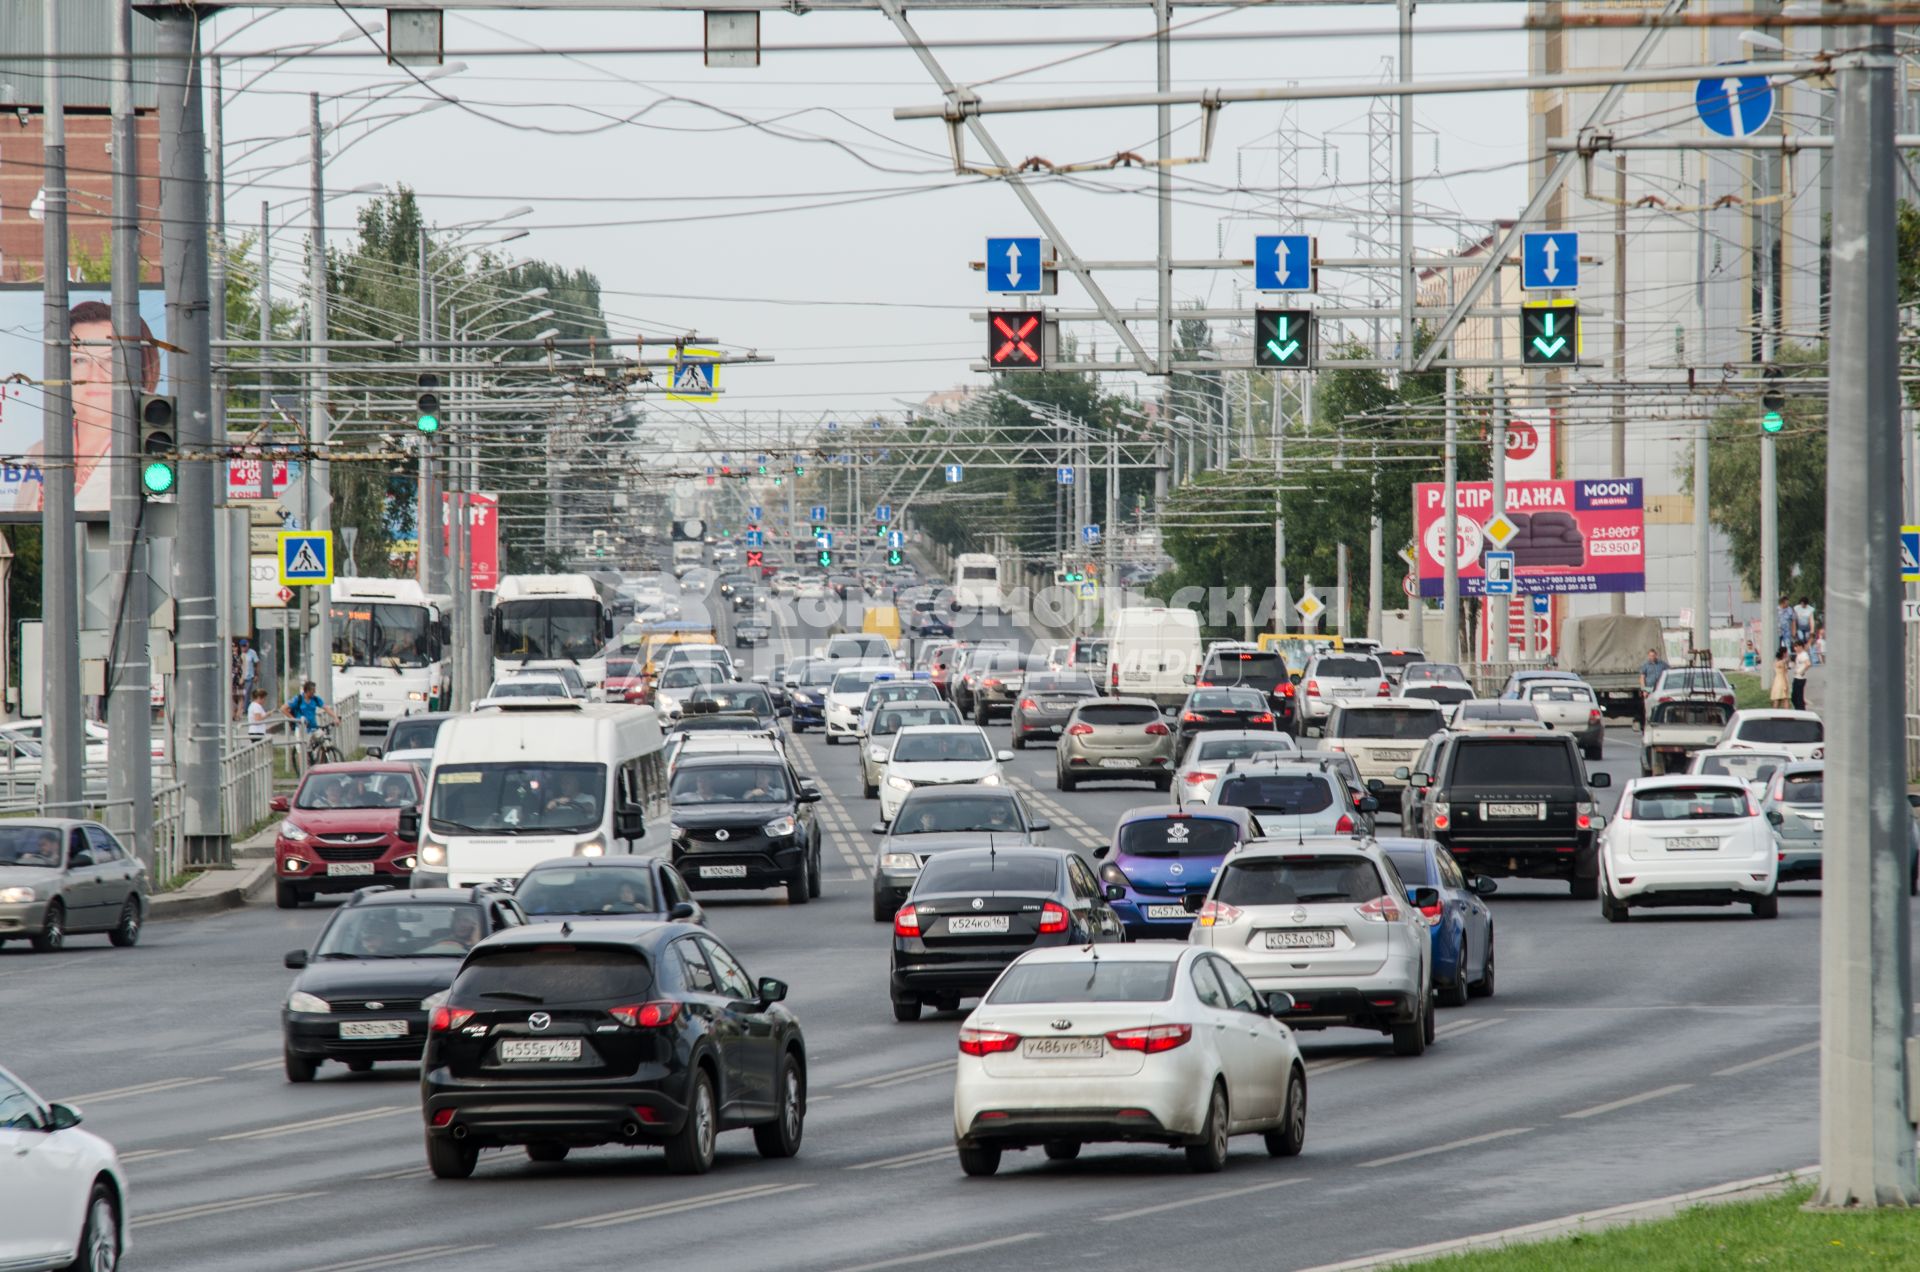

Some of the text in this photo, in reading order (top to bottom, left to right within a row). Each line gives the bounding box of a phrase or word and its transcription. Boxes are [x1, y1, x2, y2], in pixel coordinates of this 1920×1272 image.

[1428, 487, 1566, 509] РСПРДАЖА
[1584, 483, 1629, 497] MOON
[503, 808, 520, 825] 4
